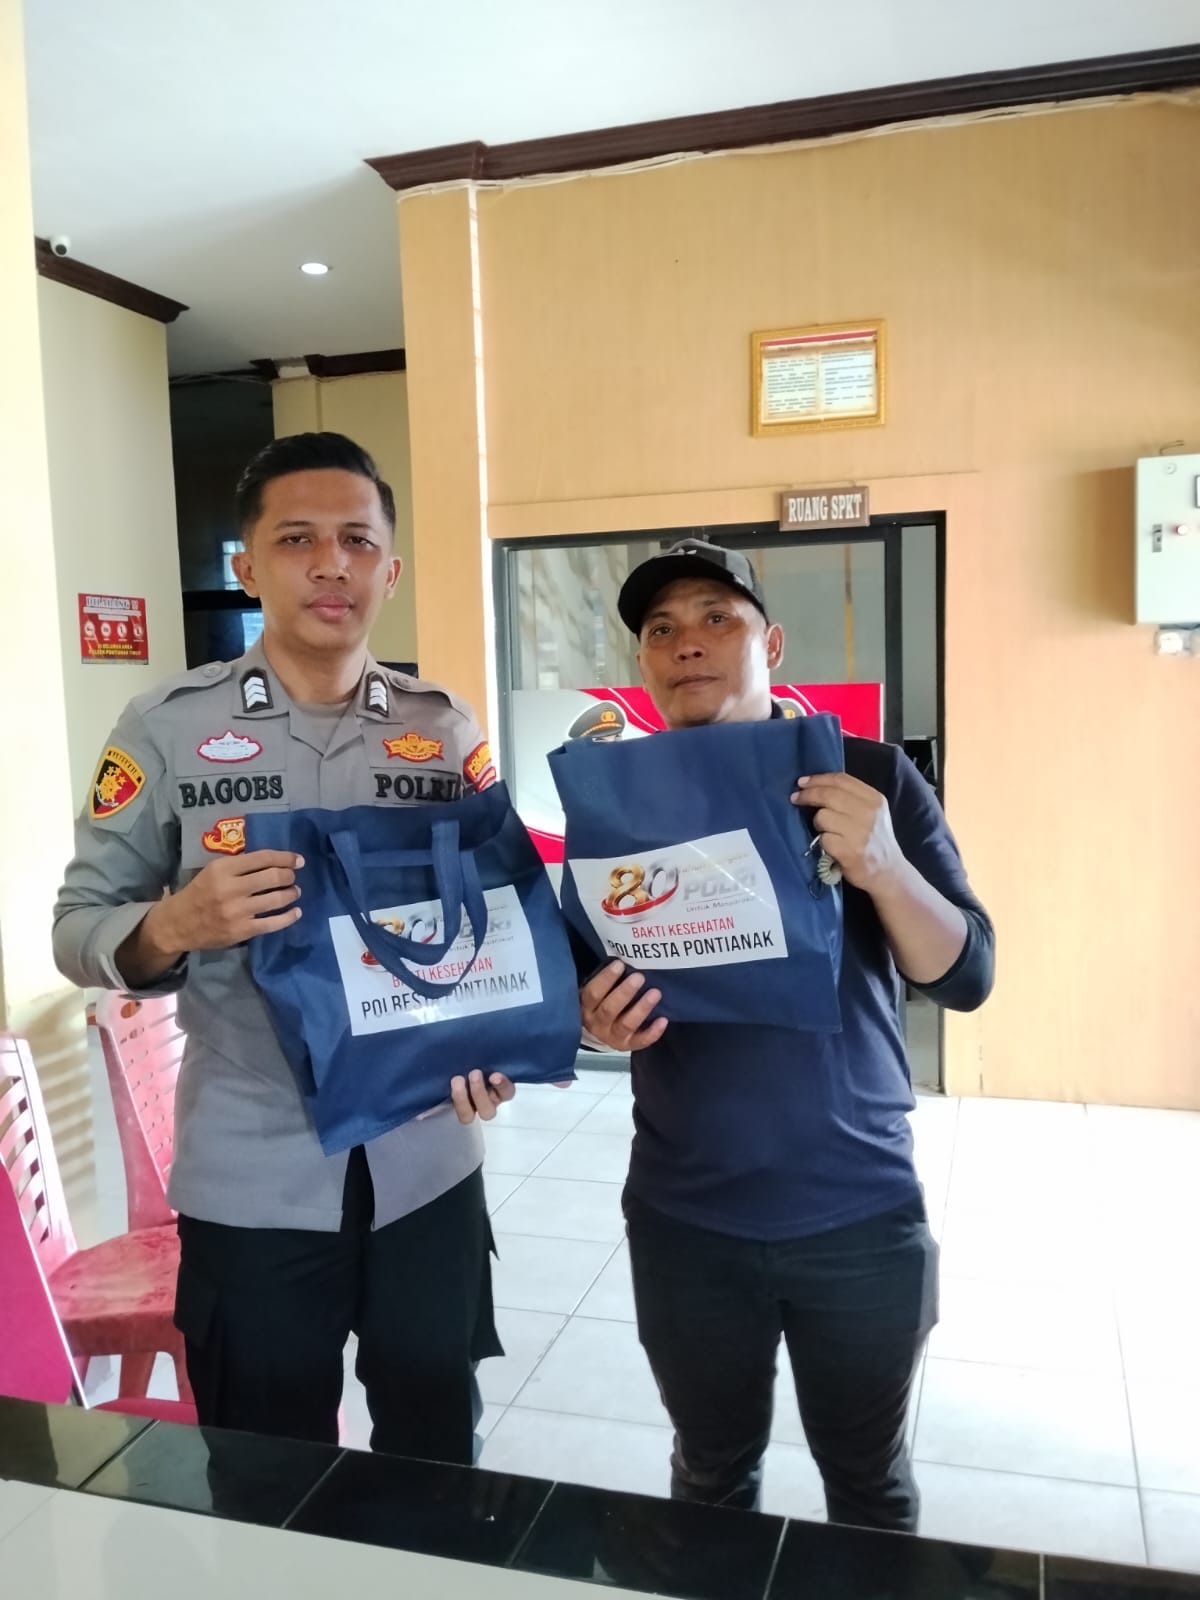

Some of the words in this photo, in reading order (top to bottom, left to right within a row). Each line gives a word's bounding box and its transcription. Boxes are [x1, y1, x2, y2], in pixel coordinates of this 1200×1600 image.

[788, 496, 828, 523] RUANG
[831, 493, 862, 520] SPKT
[178, 775, 284, 808] BAGOES
[375, 774, 460, 802] POLRI
[632, 925, 666, 939] BAKTI
[668, 916, 736, 937] KESEHATAN
[684, 930, 775, 957] PONTIANAK
